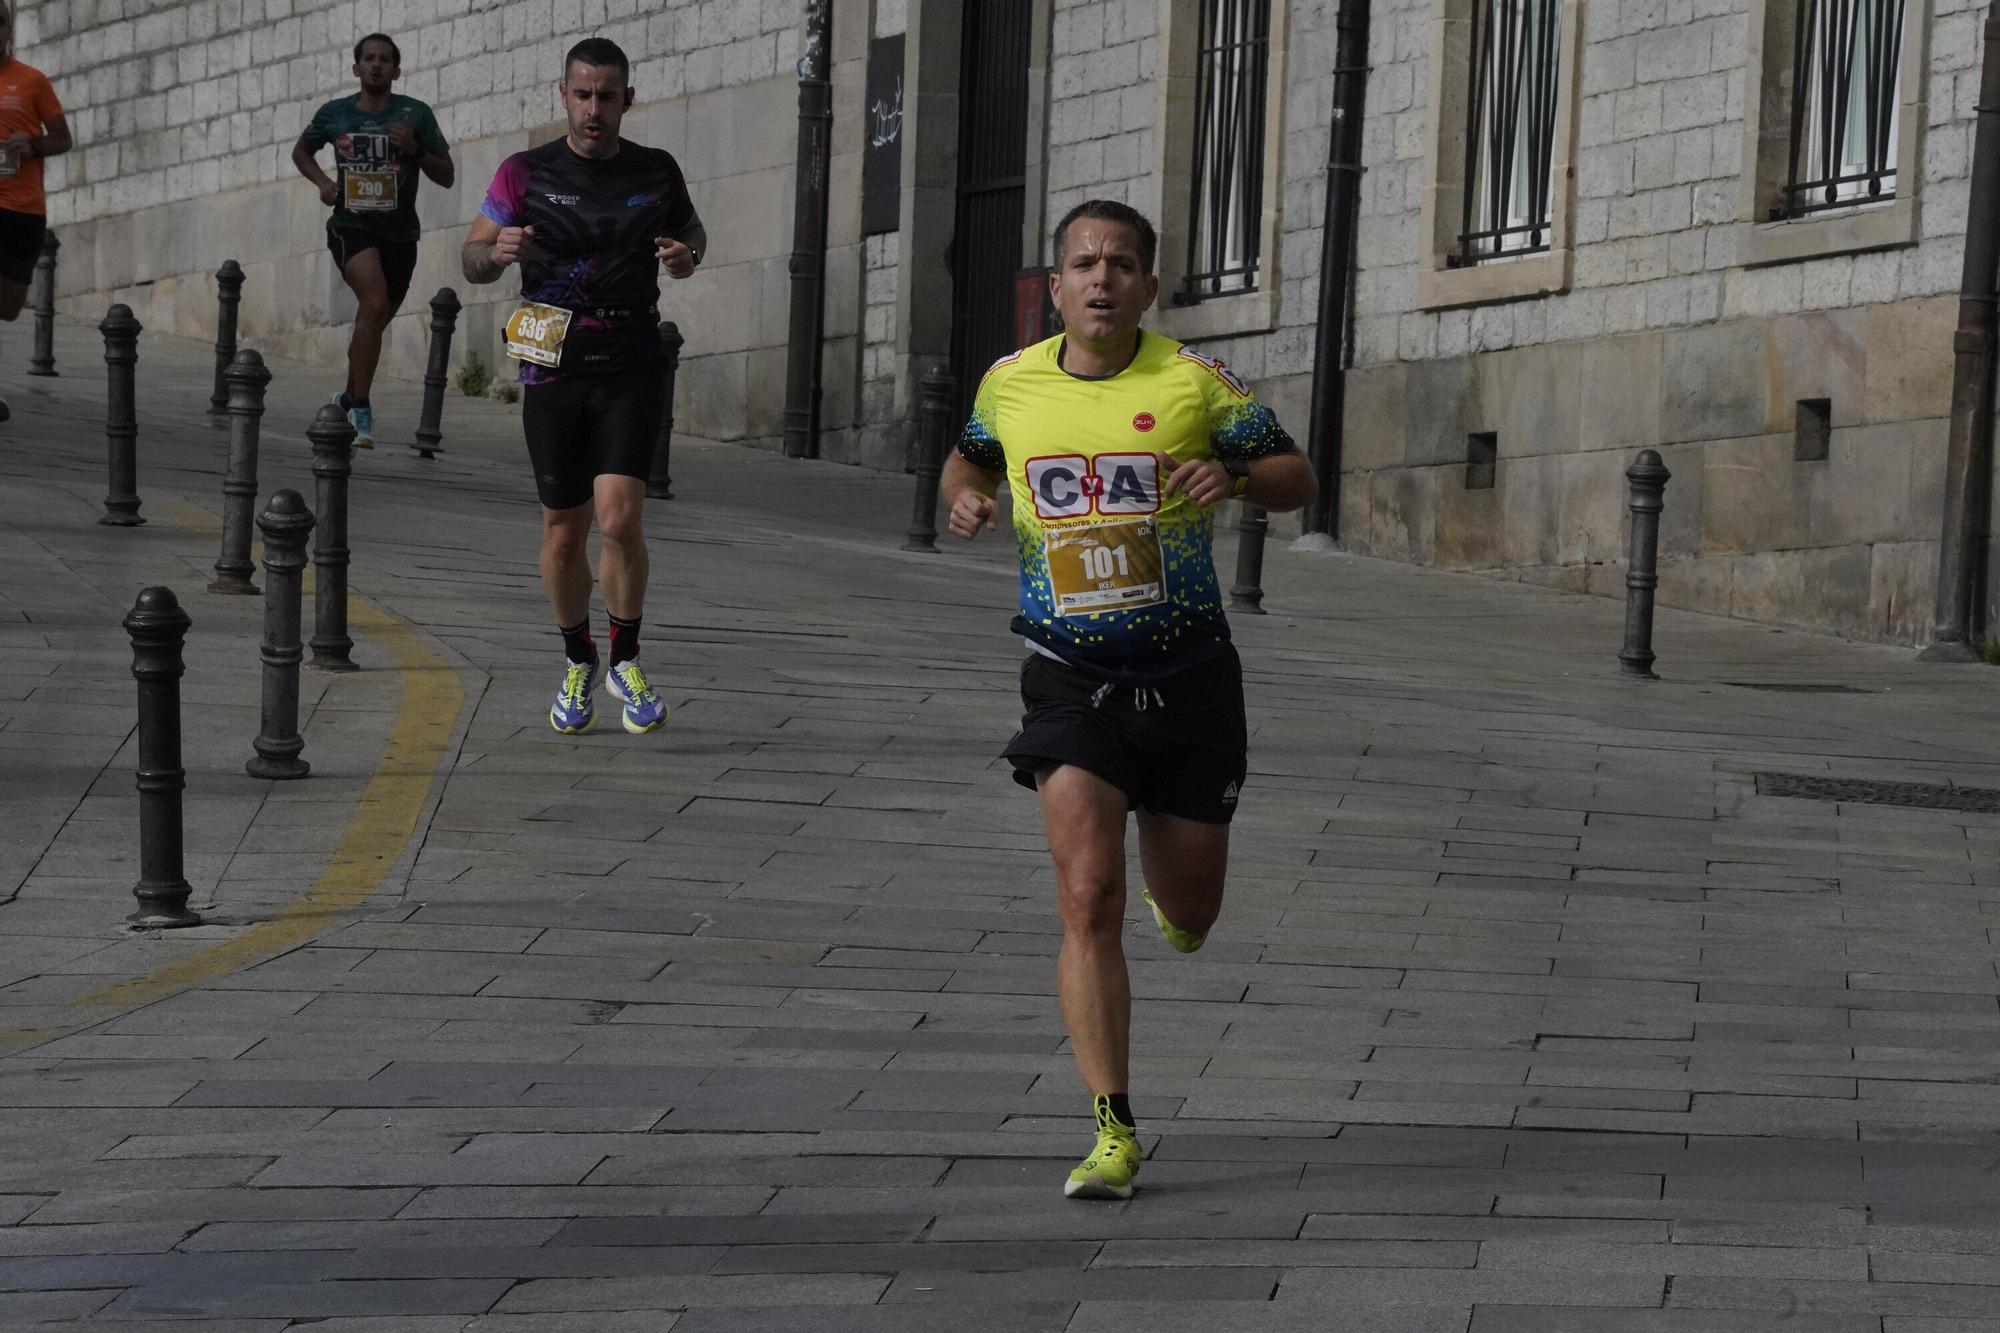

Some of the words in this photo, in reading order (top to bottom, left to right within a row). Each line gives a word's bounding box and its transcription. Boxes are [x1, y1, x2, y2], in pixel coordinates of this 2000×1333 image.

[357, 180, 383, 196] 290
[517, 315, 546, 341] 536
[1137, 526, 1153, 536] 10K
[1079, 544, 1129, 580] 101
[1098, 580, 1116, 590] IKER
